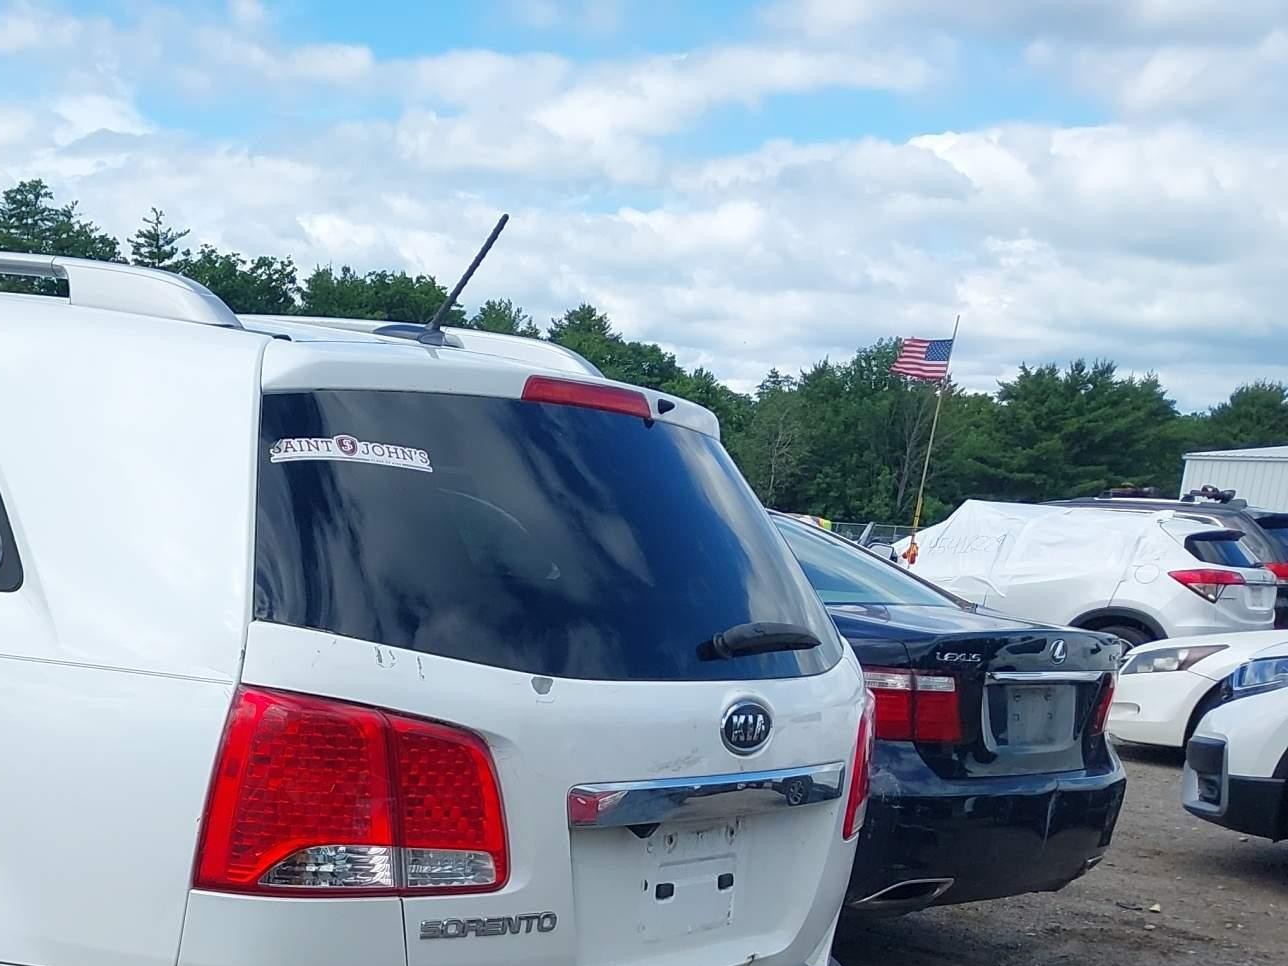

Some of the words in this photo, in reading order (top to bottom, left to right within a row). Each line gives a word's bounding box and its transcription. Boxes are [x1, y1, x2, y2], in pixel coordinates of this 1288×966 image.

[361, 442, 428, 464] JOHN'S
[936, 651, 983, 663] LEXUS
[731, 713, 765, 742] KIA
[420, 911, 558, 940] SORENTO
